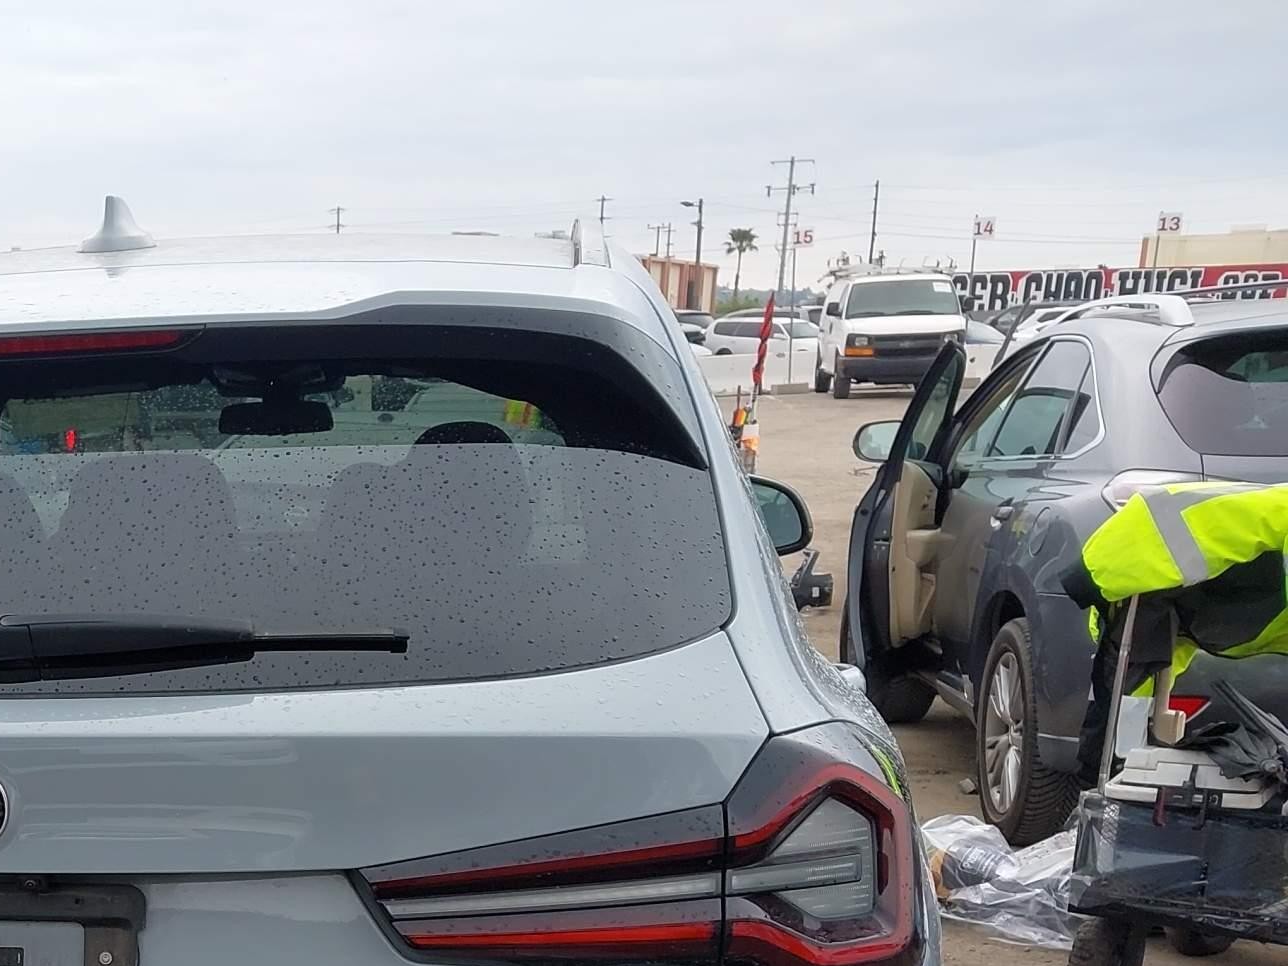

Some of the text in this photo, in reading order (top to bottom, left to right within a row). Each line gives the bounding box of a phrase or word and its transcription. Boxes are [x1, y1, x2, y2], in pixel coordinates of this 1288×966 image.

[973, 220, 994, 236] 14
[1158, 217, 1181, 232] 13
[793, 230, 814, 245] 15
